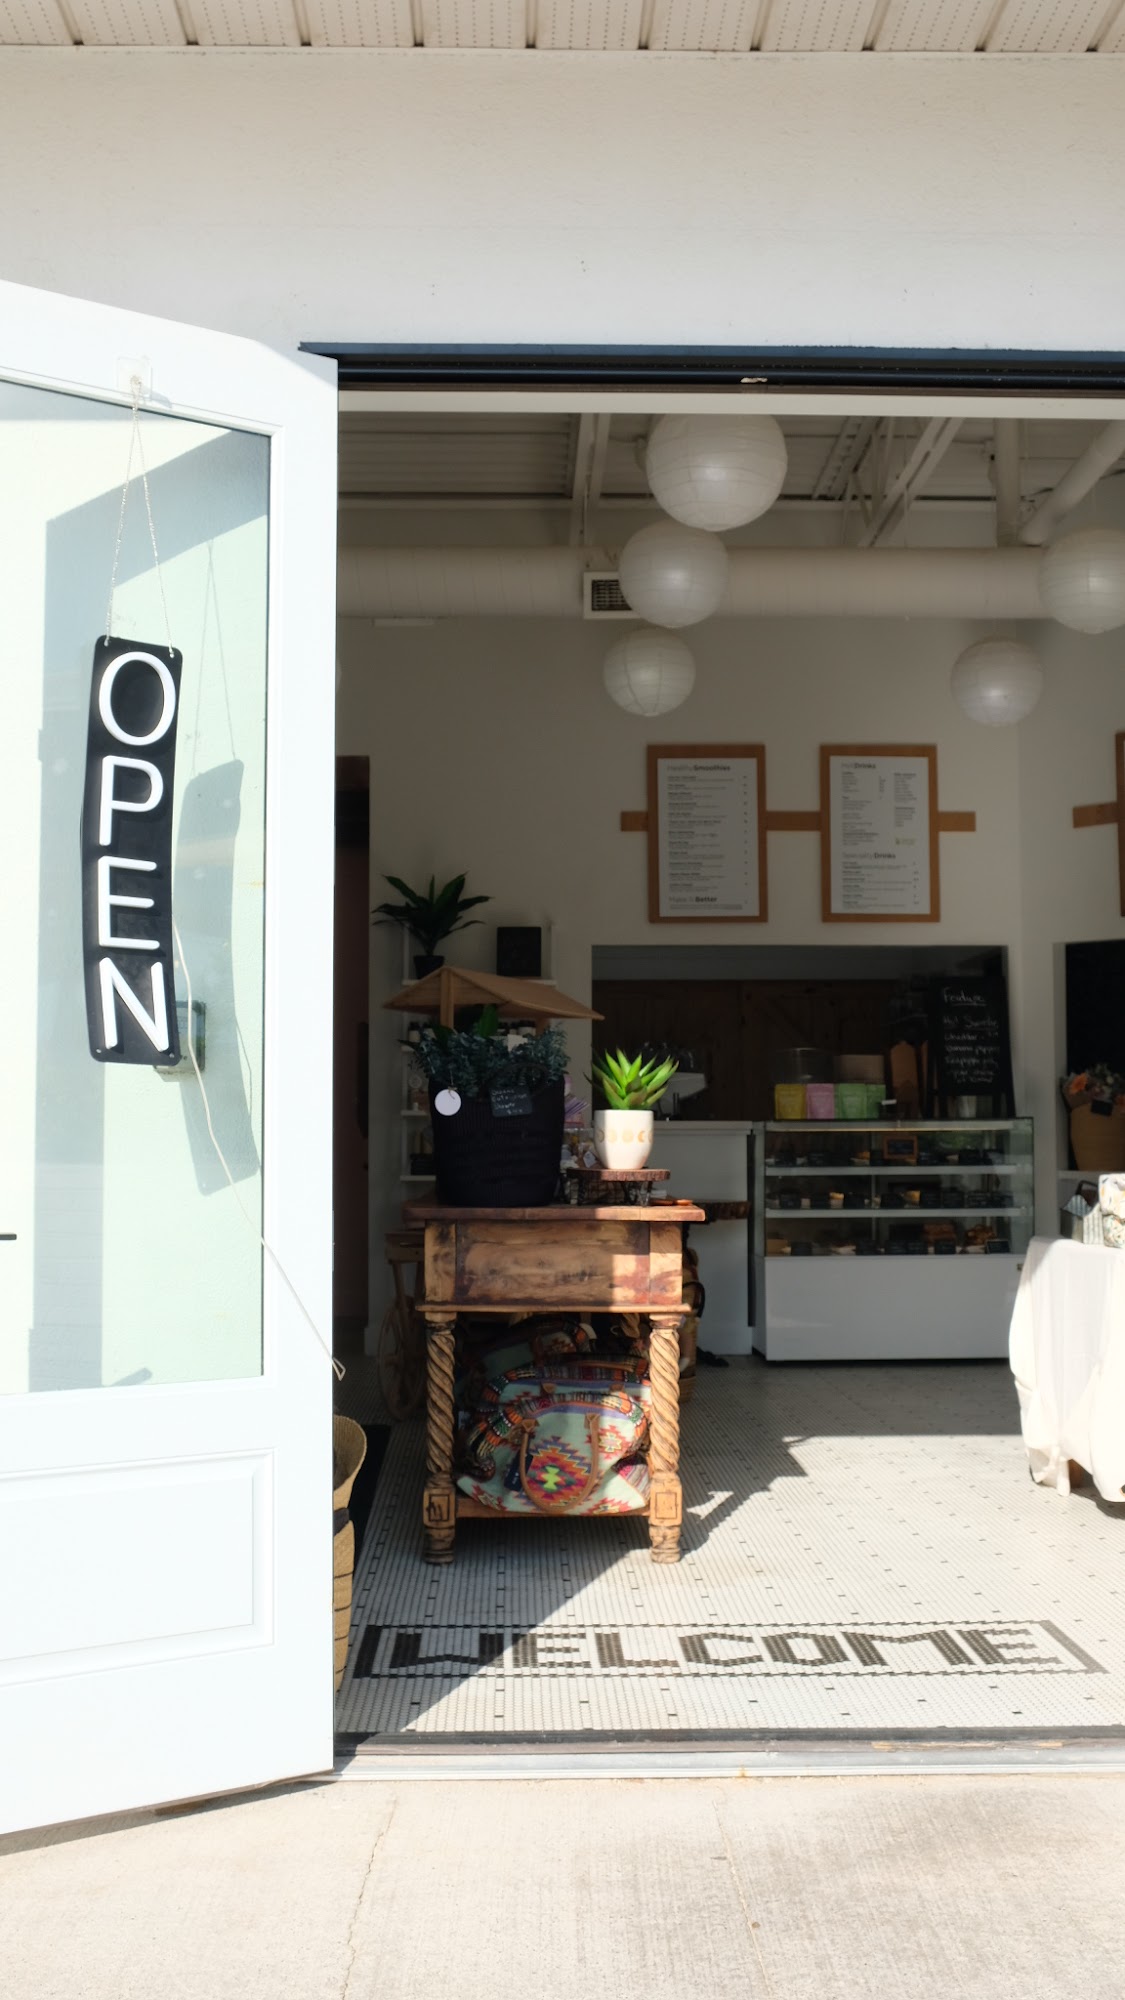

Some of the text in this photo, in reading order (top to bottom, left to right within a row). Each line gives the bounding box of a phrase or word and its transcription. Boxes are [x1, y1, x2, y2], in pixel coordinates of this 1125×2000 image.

[693, 764, 731, 772] Smoothies
[98, 651, 176, 1052] OPEN
[874, 852, 896, 860] Drinks
[695, 895, 718, 903] Better
[389, 1629, 1064, 1668] WELCOME
